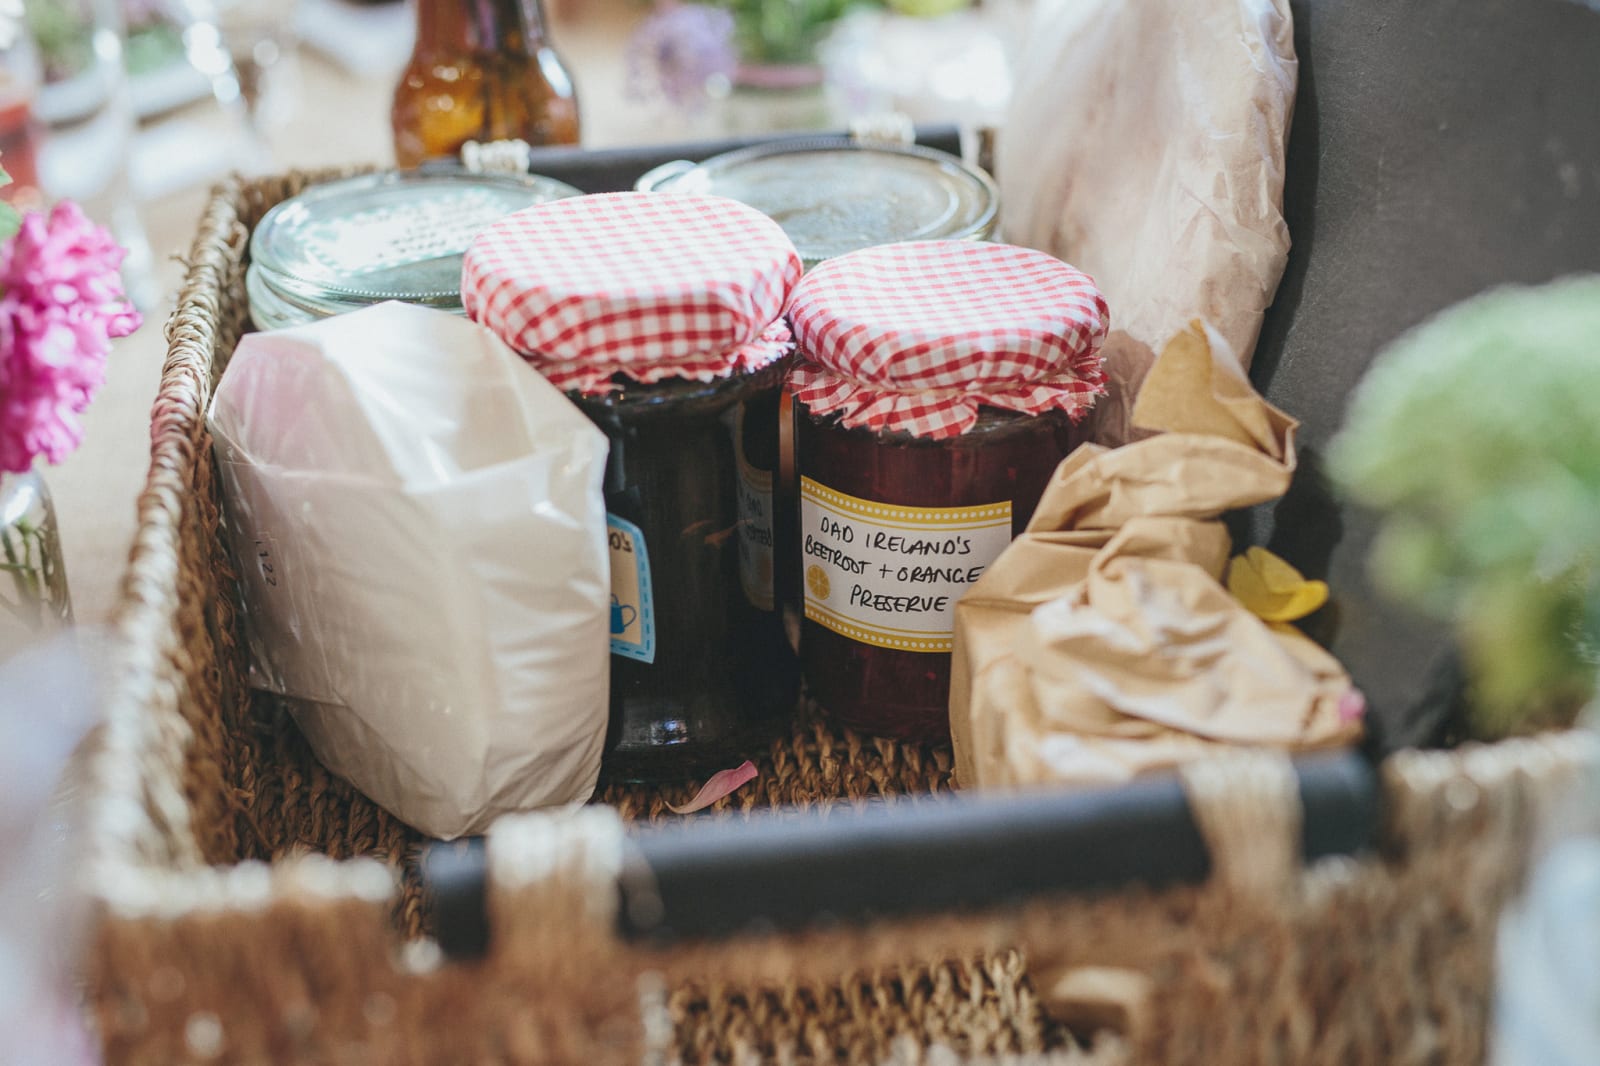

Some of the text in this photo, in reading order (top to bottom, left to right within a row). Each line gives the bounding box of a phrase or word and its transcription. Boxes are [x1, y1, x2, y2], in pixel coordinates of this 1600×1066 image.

[820, 516, 971, 555] DAD IRELAND'S
[805, 534, 984, 583] BEETROOT + ORANGE
[850, 584, 949, 612] PRESERVE
